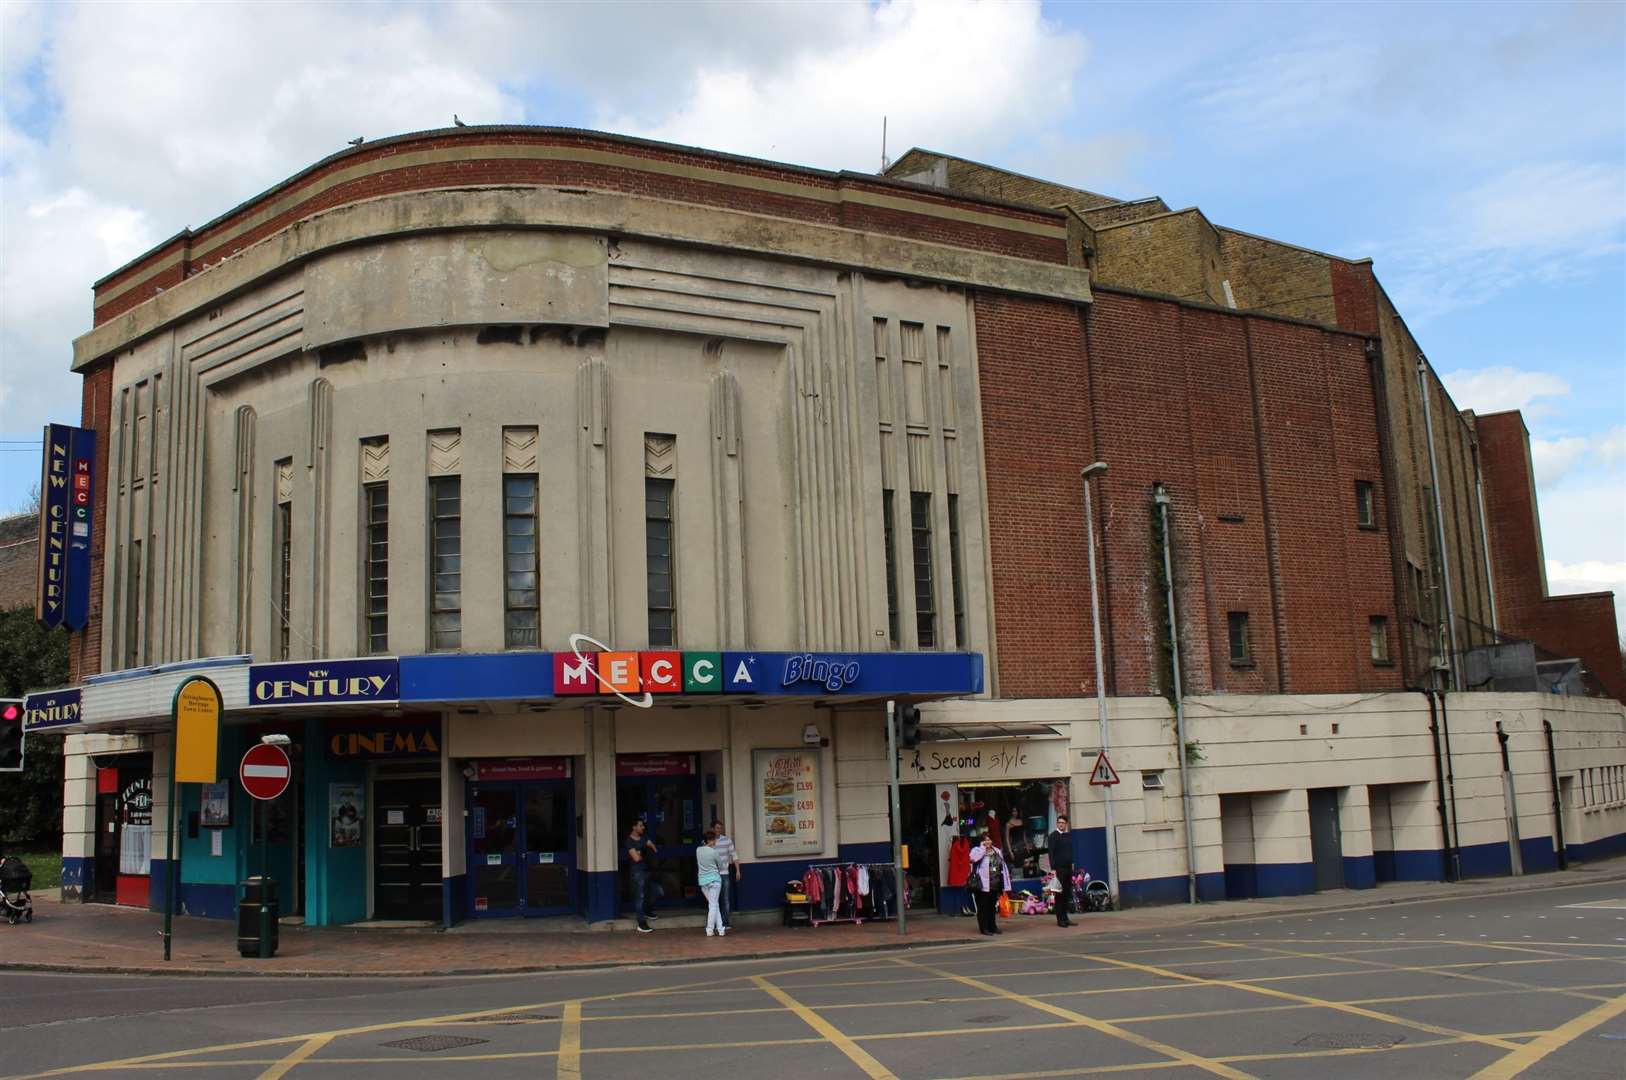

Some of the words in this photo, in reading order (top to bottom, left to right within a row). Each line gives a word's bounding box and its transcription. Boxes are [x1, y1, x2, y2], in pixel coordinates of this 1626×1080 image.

[50, 443, 66, 489] NEW
[48, 504, 64, 613] CENTURY
[308, 670, 330, 678] NEW
[563, 659, 753, 686] MECCA
[783, 653, 860, 691] Bingo
[255, 674, 391, 701] CENTURY
[330, 730, 439, 756] CINEMA
[930, 751, 981, 770] Second
[988, 745, 1028, 774] style
